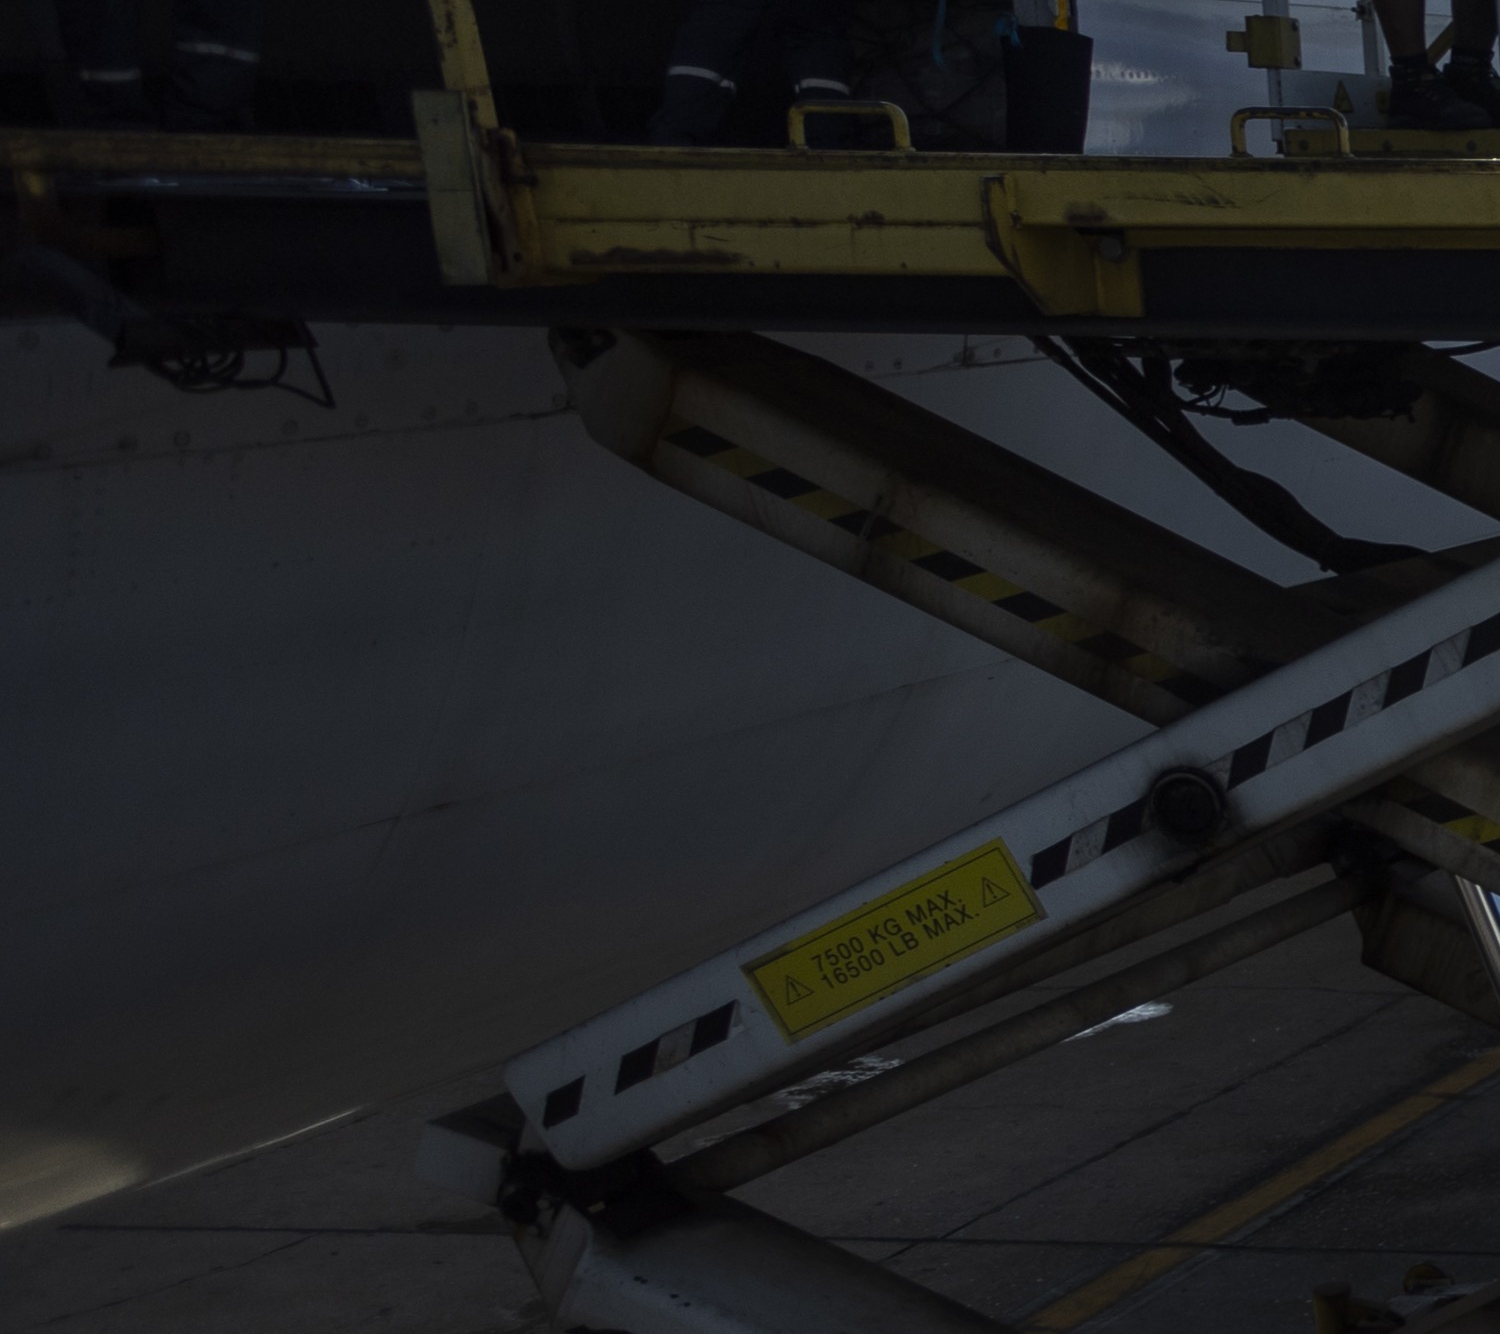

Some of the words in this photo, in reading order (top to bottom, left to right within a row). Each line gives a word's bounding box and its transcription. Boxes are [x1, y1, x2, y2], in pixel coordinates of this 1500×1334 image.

[811, 936, 865, 972] 7500
[867, 917, 903, 945] KG
[905, 889, 963, 926] MAX.
[821, 948, 886, 990] 16500
[888, 930, 919, 958] LB
[922, 903, 981, 940] MAX.
